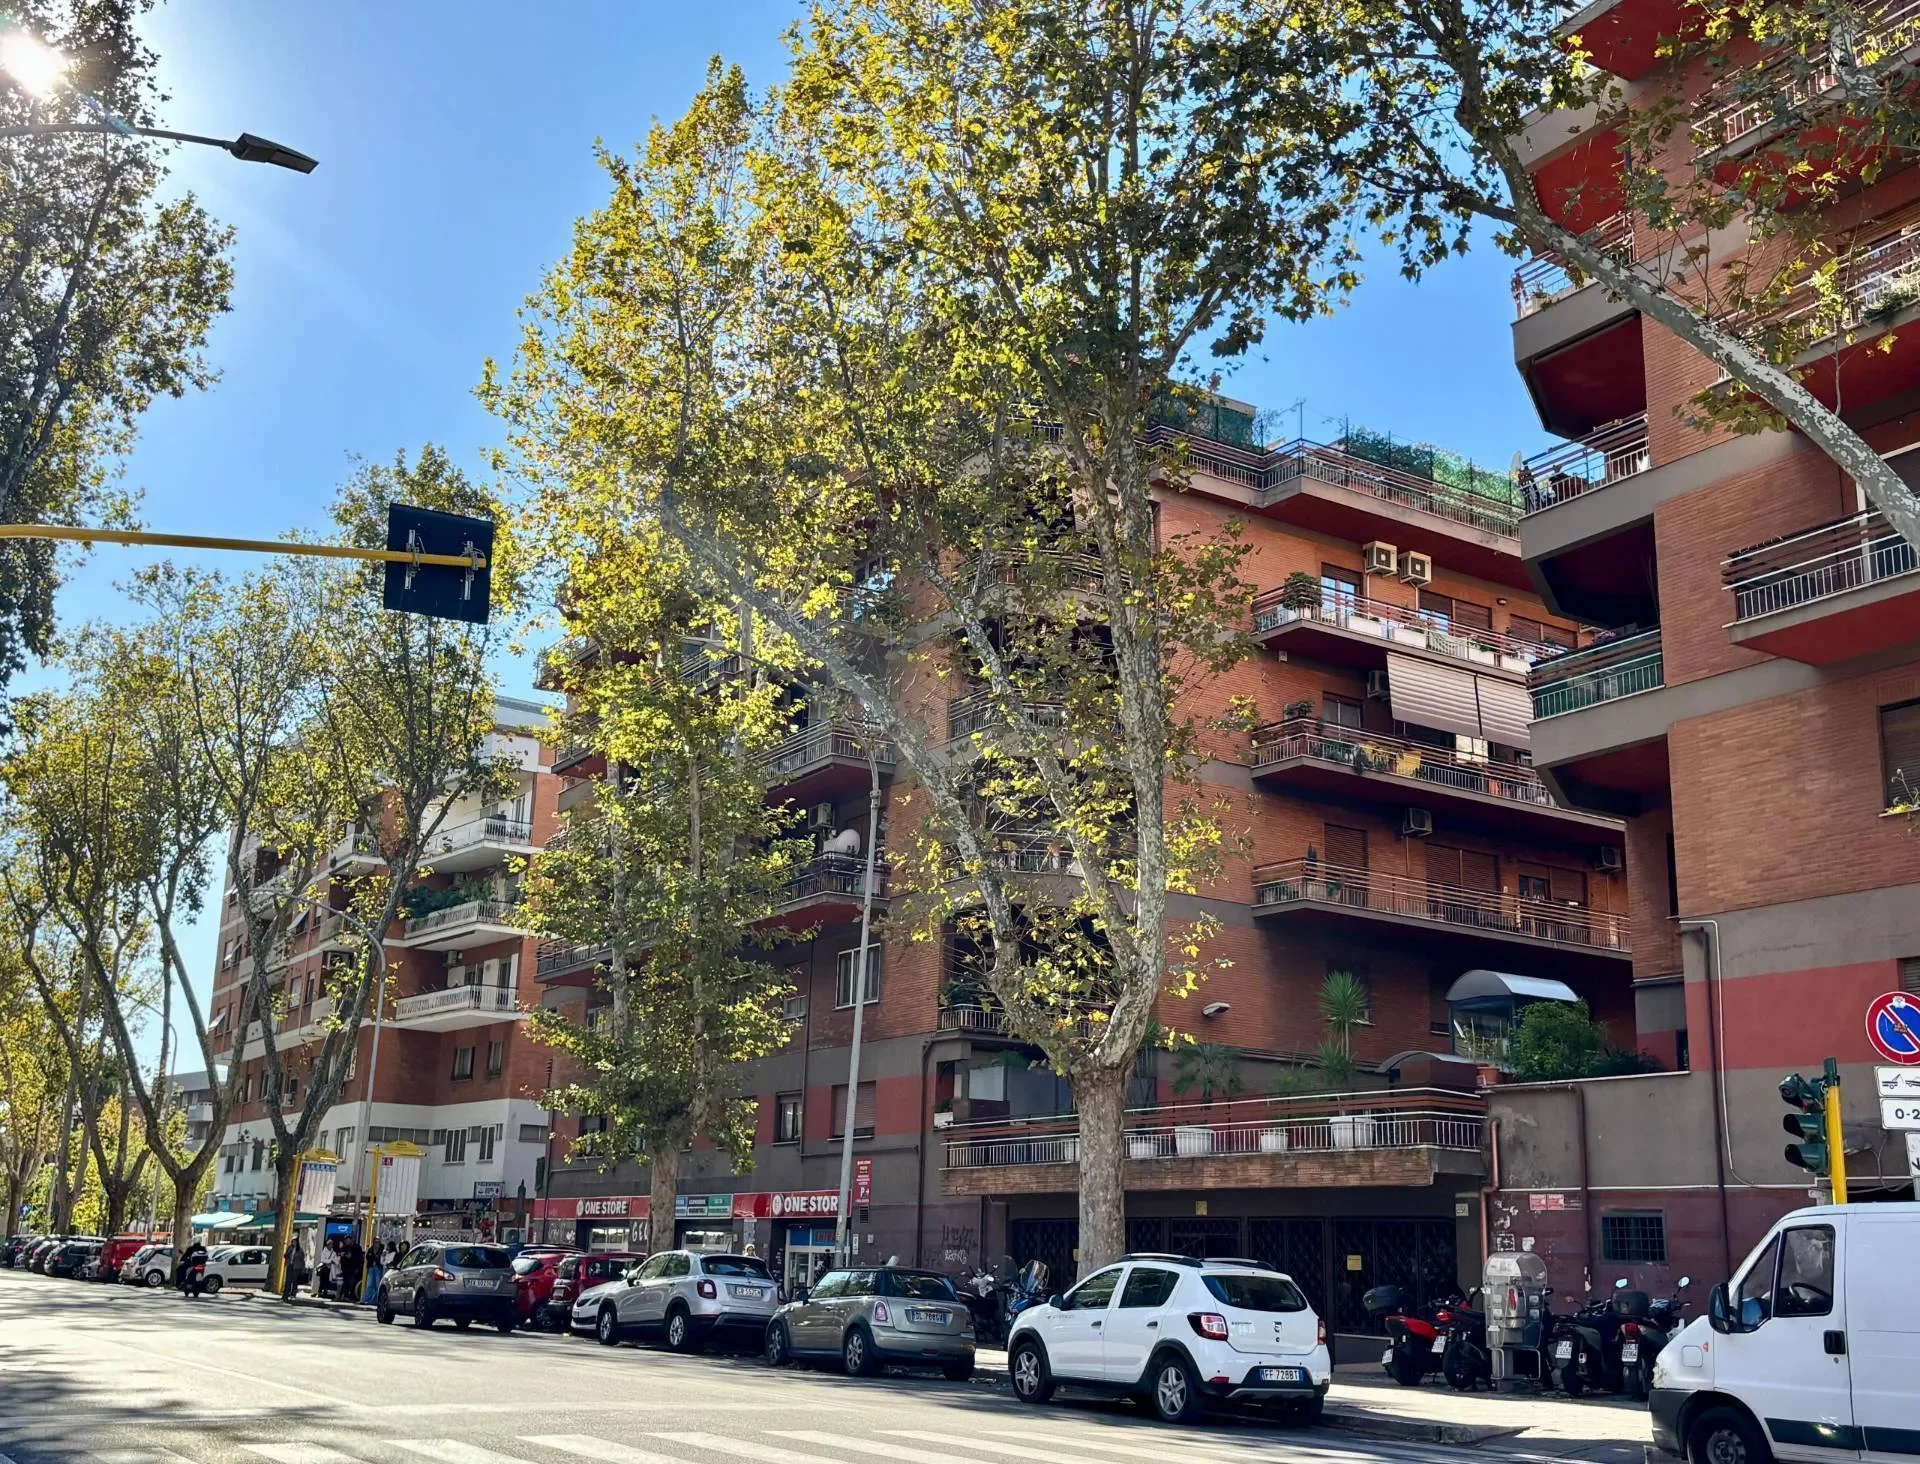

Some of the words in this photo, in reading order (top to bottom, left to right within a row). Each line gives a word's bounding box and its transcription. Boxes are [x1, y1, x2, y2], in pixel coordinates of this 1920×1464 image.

[585, 1201, 601, 1215] ONE
[602, 1200, 627, 1215] STORE
[784, 1196, 807, 1213] ONE
[809, 1195, 840, 1212] STOR
